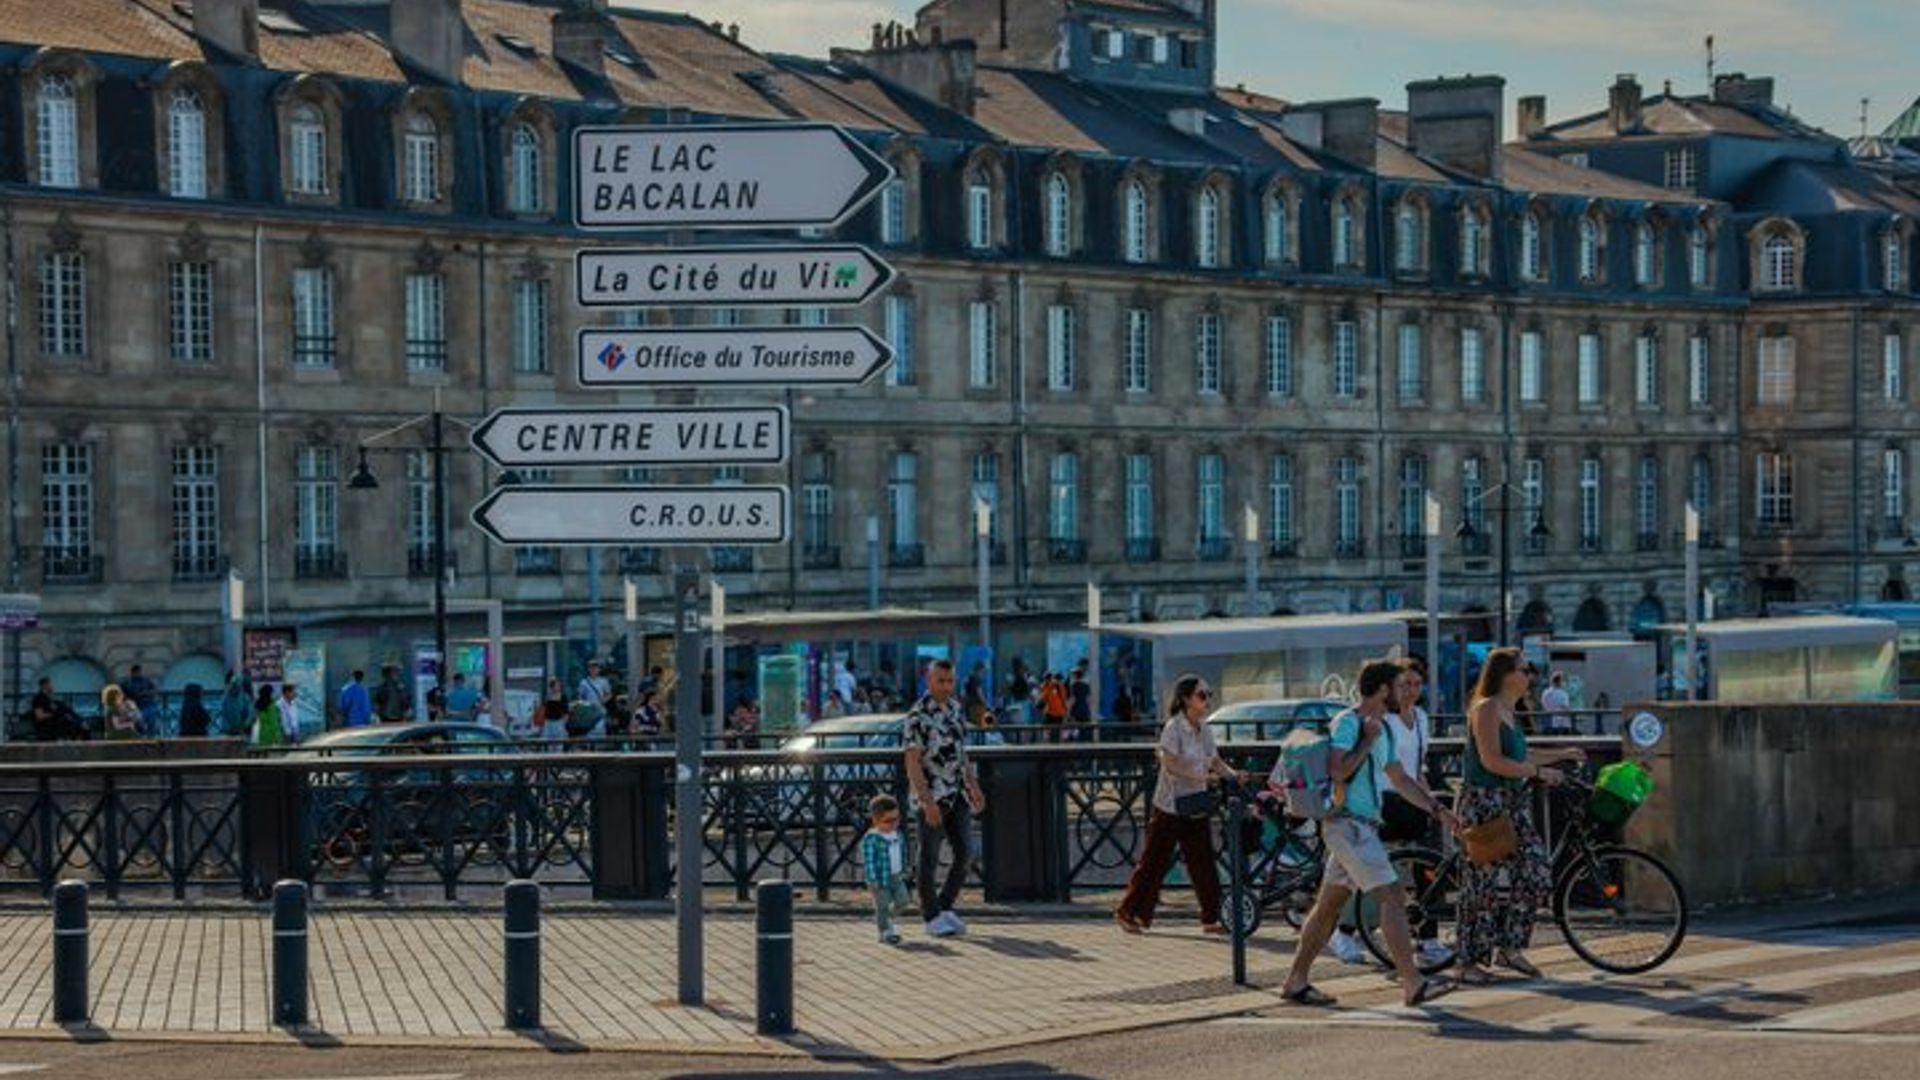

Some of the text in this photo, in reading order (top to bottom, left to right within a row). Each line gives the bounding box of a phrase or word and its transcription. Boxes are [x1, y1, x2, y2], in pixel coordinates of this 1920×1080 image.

[592, 143, 717, 173] LE LAC
[593, 181, 760, 212] BACALAN
[593, 265, 629, 293] La
[648, 263, 719, 292] Cité
[739, 264, 778, 291] du
[634, 345, 856, 369] Office du Tourisme
[516, 421, 771, 452] CENTRE VILLE
[629, 503, 770, 527] C.R.O.U.S.
